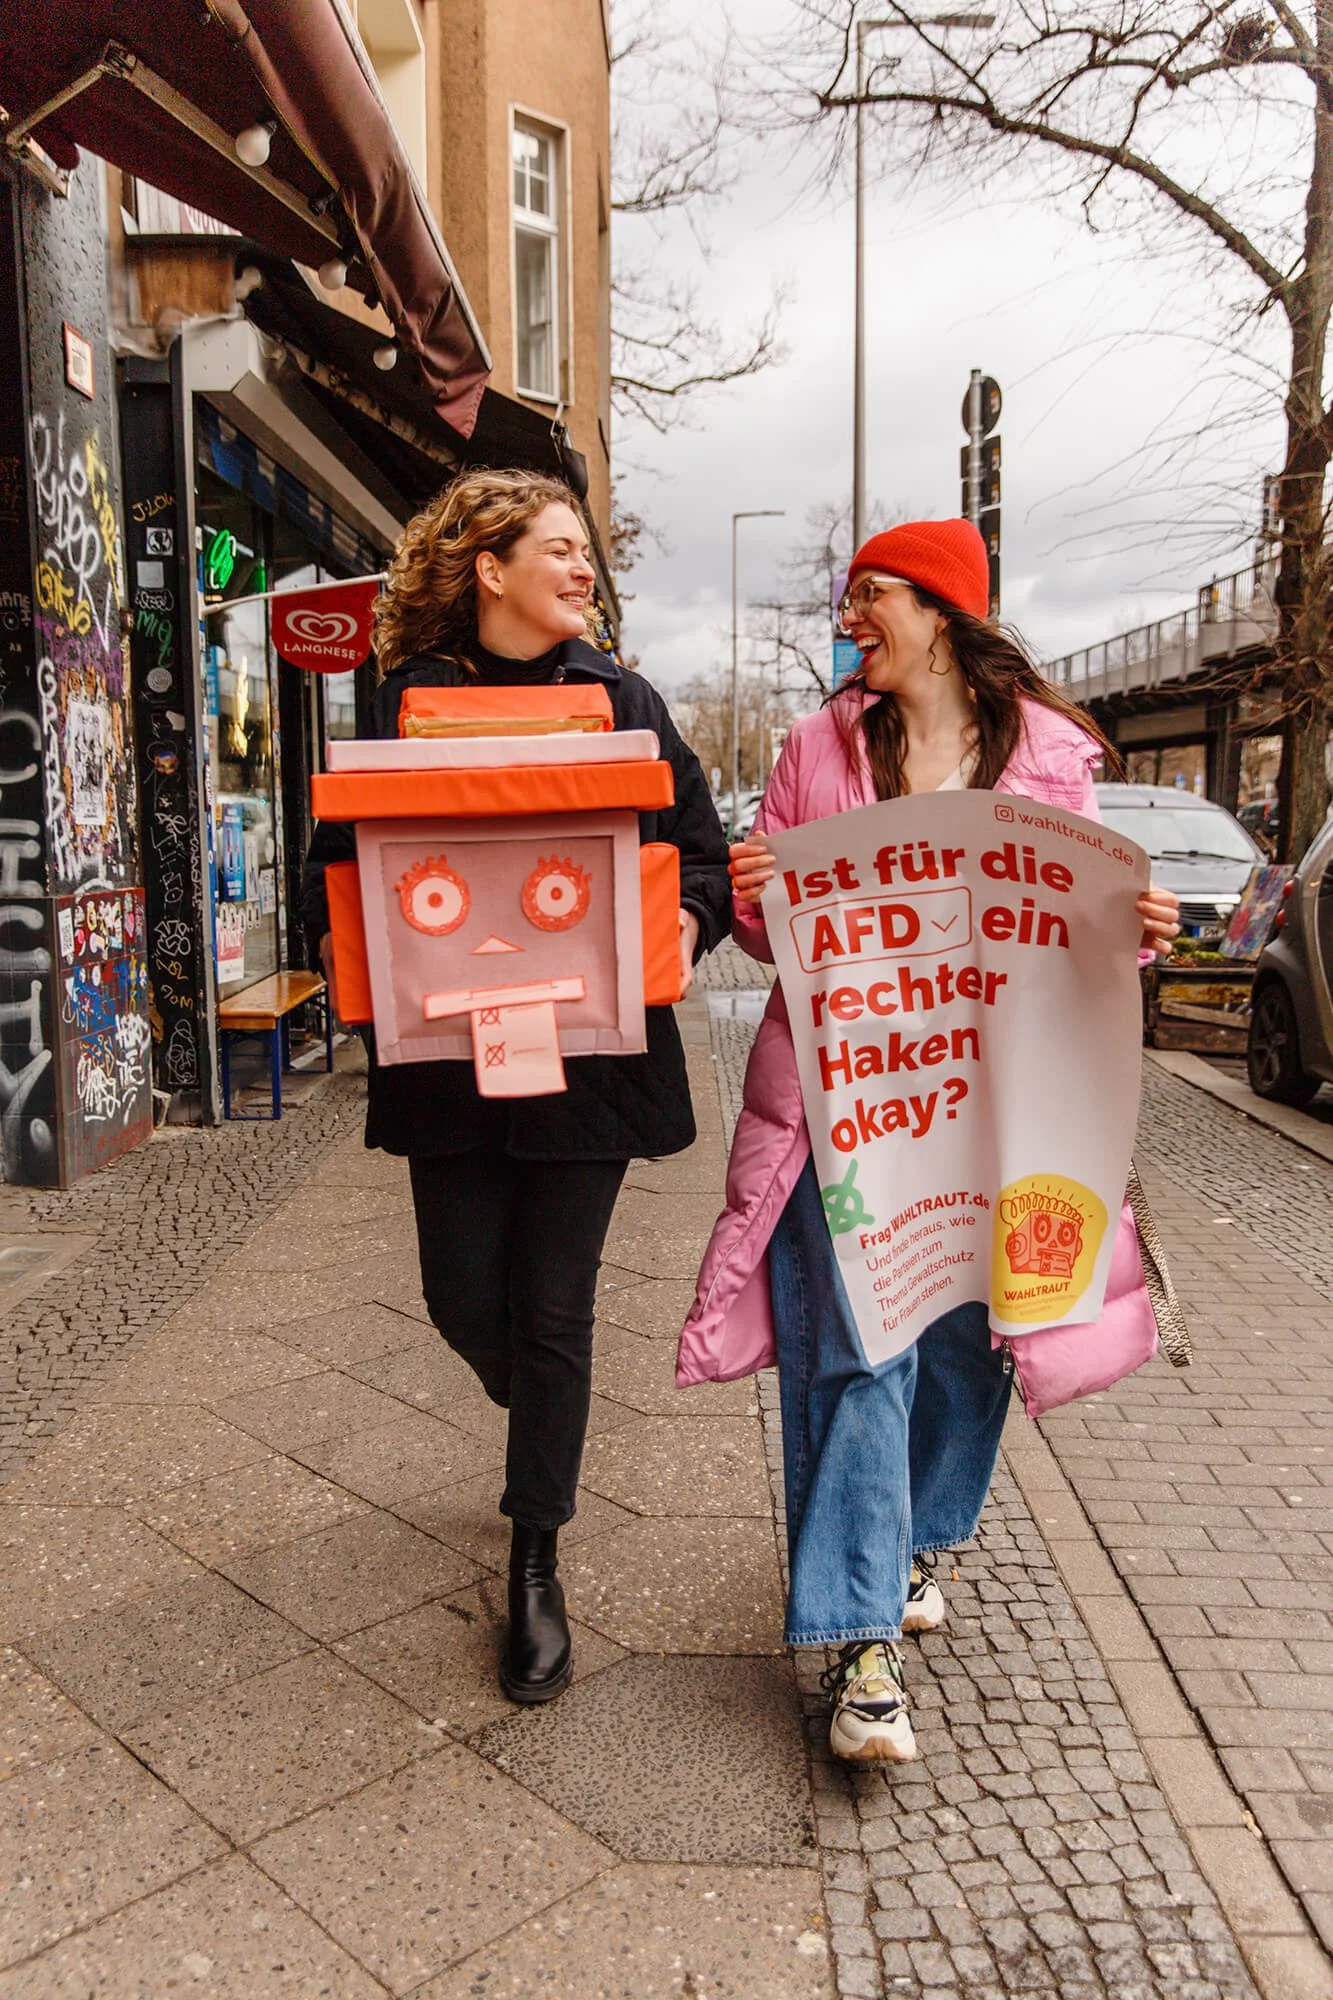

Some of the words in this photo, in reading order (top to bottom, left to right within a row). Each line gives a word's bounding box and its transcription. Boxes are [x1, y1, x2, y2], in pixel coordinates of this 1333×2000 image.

[283, 642, 357, 661] LANGNESE
[1018, 812, 1134, 866] wahltraut_de
[782, 857, 861, 907] Ist
[872, 840, 967, 887] für
[979, 841, 1075, 894] die
[810, 903, 921, 964] AFD
[980, 897, 1071, 949] ein
[809, 963, 1009, 1029] rechter
[816, 1027, 981, 1093] Haken
[830, 1077, 970, 1154] okay?
[859, 1226, 892, 1250] Frag
[889, 1191, 990, 1233] WAHLTRAUT.de
[865, 1250, 892, 1272] Und
[891, 1239, 910, 1259] finde
[908, 1221, 946, 1246] heraus,
[948, 1213, 976, 1228] wie
[872, 1277, 893, 1293] die
[891, 1252, 921, 1282] Parteien
[920, 1240, 944, 1260] zum
[877, 1285, 909, 1313] Thema
[907, 1250, 976, 1291] Gewaltschutz
[1003, 1282, 1071, 1301] WAHLTRAUT
[882, 1315, 900, 1334] für
[920, 1275, 955, 1302] stehen.
